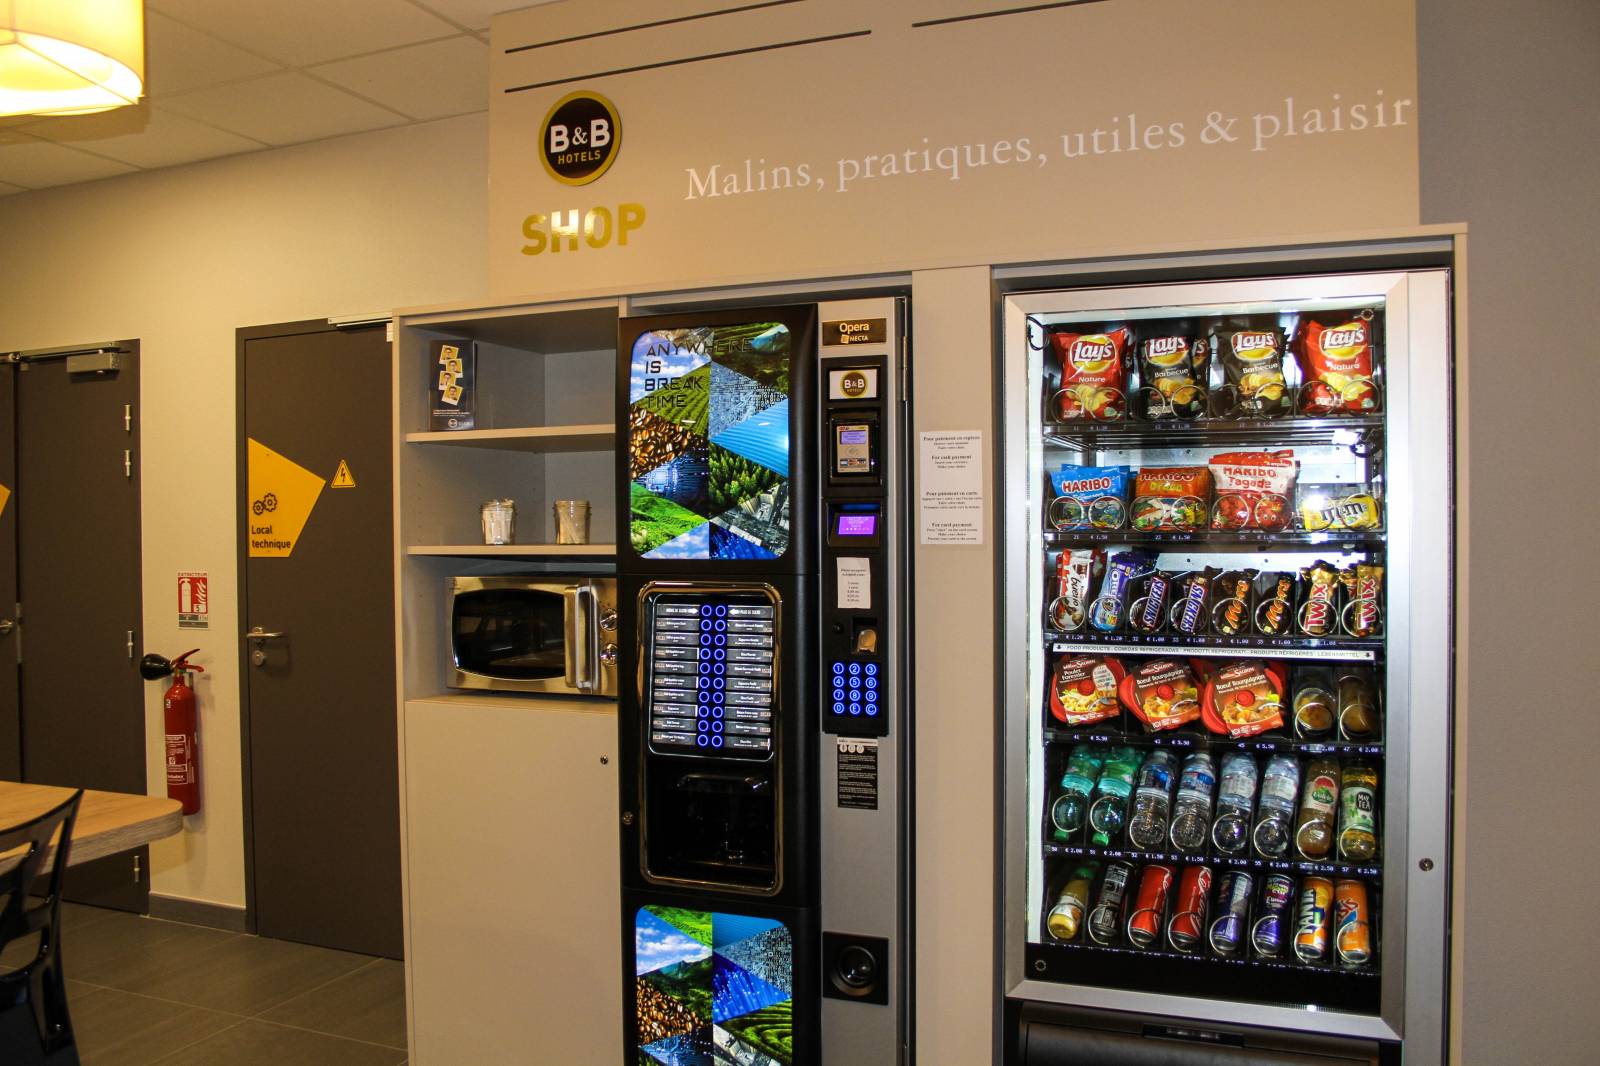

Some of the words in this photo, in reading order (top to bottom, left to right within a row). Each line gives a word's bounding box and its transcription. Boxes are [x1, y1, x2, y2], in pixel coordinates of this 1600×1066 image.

[550, 118, 612, 154] B&B
[685, 160, 825, 200] Malins,
[836, 136, 1047, 194] pratiques,
[1061, 113, 1186, 158] utiles
[1199, 111, 1239, 144] &
[1251, 89, 1412, 152] plaisir
[557, 150, 601, 166] HOTELS
[521, 203, 646, 256] SHOP
[839, 322, 870, 334] Opera
[646, 338, 754, 357] ANYWHERE
[646, 360, 662, 374] IS
[1154, 368, 1188, 378] Barbecue
[1242, 362, 1278, 374] Barbecue
[644, 376, 703, 392] BREAK
[646, 394, 687, 408] TIME
[1224, 466, 1276, 478] HARIBO
[1062, 478, 1110, 493] HARIBO
[1229, 477, 1272, 488] Tagada
[251, 525, 273, 535] Local
[252, 538, 291, 551] technique
[1144, 578, 1166, 627] SNICKERS
[1181, 584, 1203, 632] SNICKERS
[1307, 584, 1328, 630] TWIX
